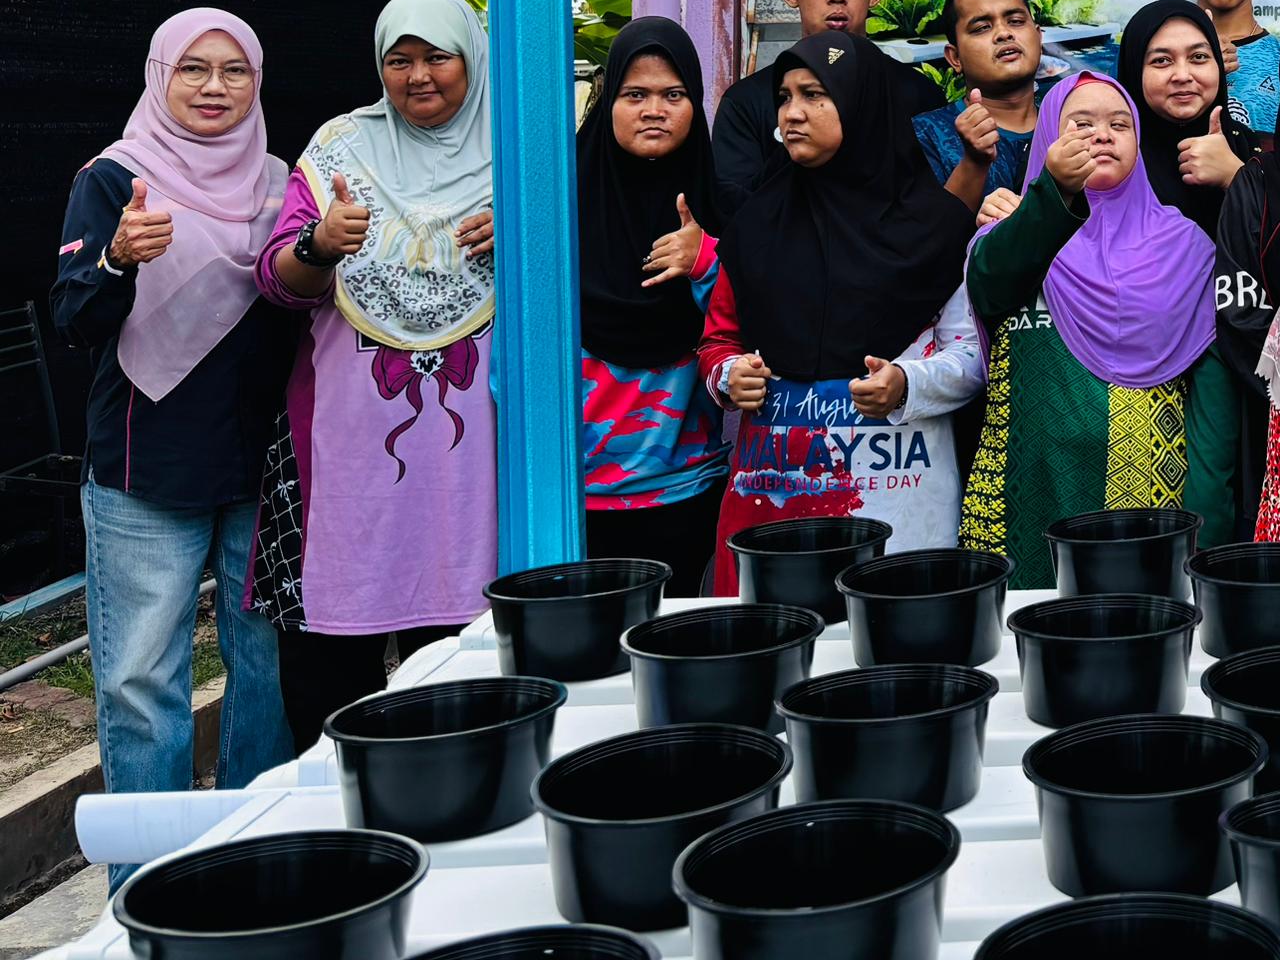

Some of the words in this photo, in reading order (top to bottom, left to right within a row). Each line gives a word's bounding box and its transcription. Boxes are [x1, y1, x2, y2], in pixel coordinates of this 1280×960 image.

[771, 390, 790, 422] 31
[738, 430, 931, 472] MALAYSIA
[886, 473, 922, 489] DAY
